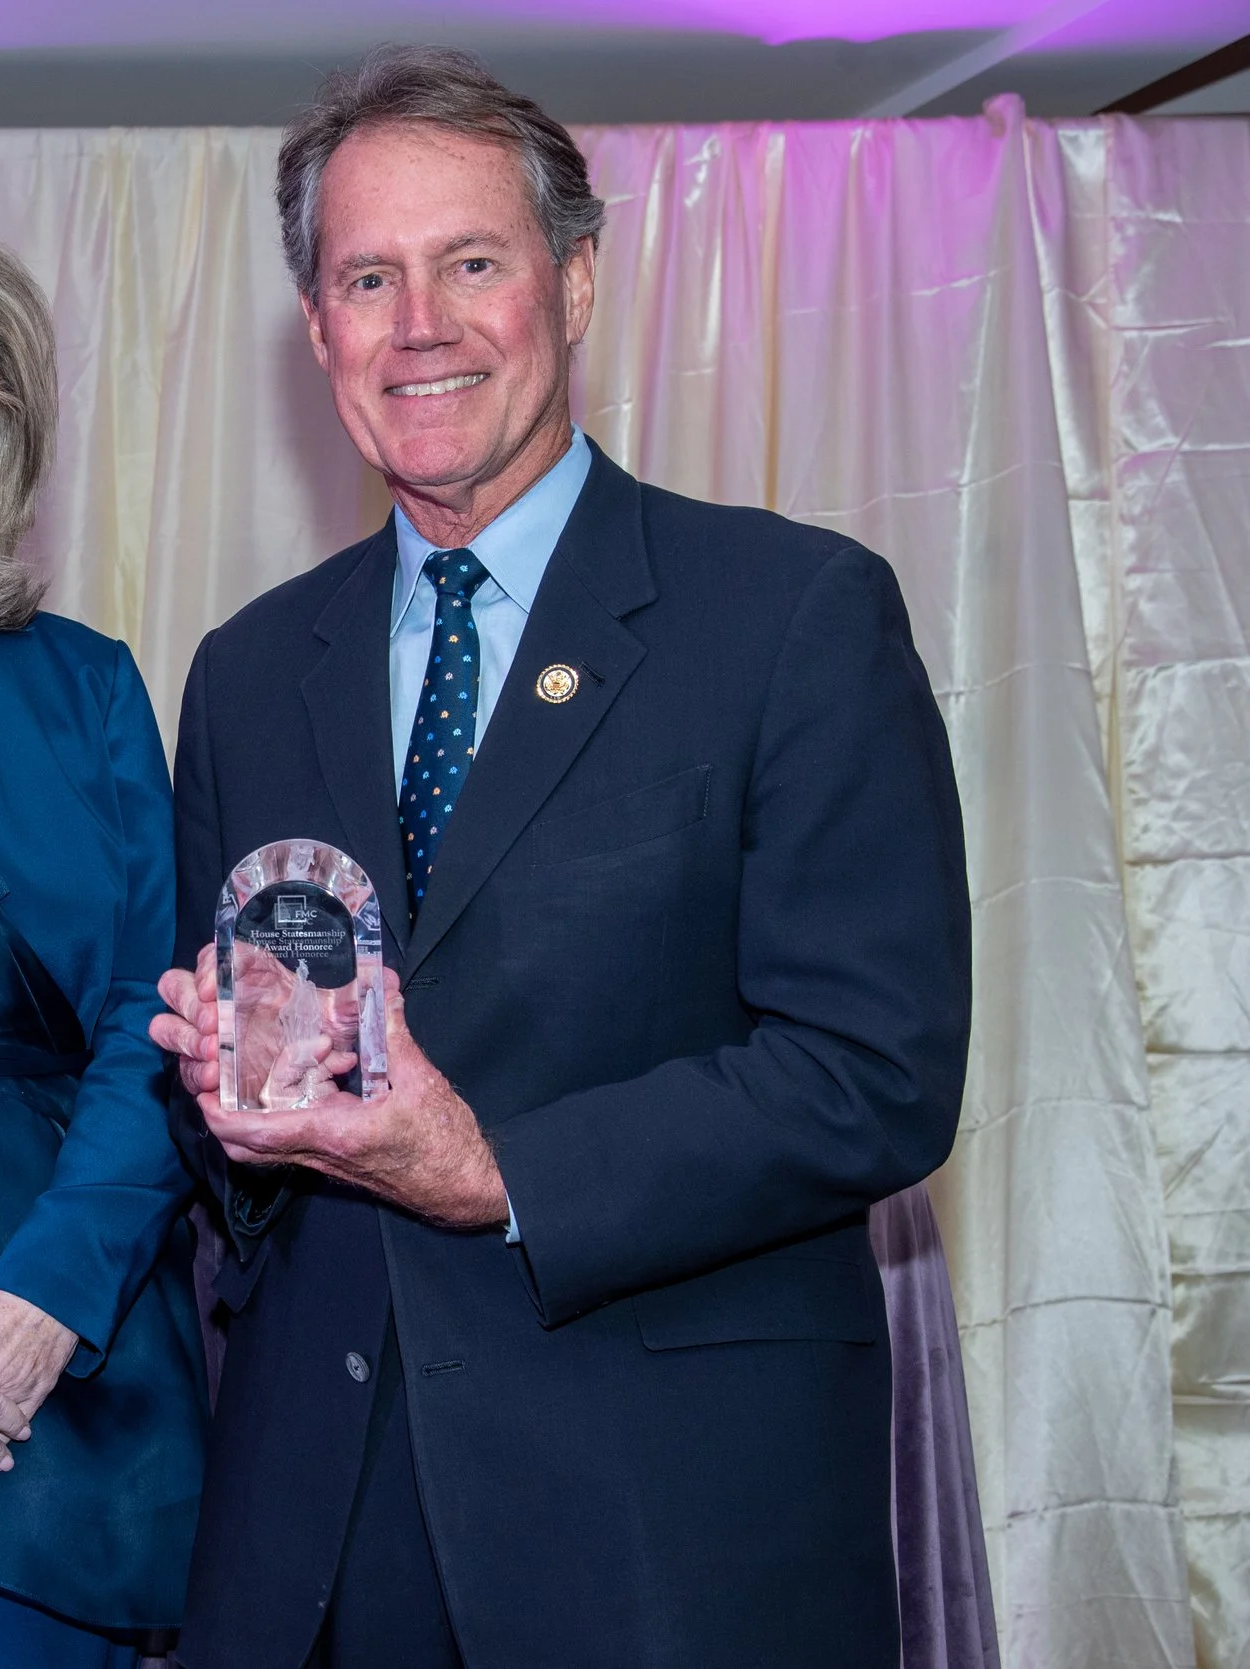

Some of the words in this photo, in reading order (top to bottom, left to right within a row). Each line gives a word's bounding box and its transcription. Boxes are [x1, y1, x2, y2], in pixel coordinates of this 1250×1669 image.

[295, 910, 317, 918] FMC
[250, 930, 280, 938] House
[282, 929, 346, 939] Statesmanship
[264, 943, 292, 951] Award
[294, 942, 333, 951] Honoree
